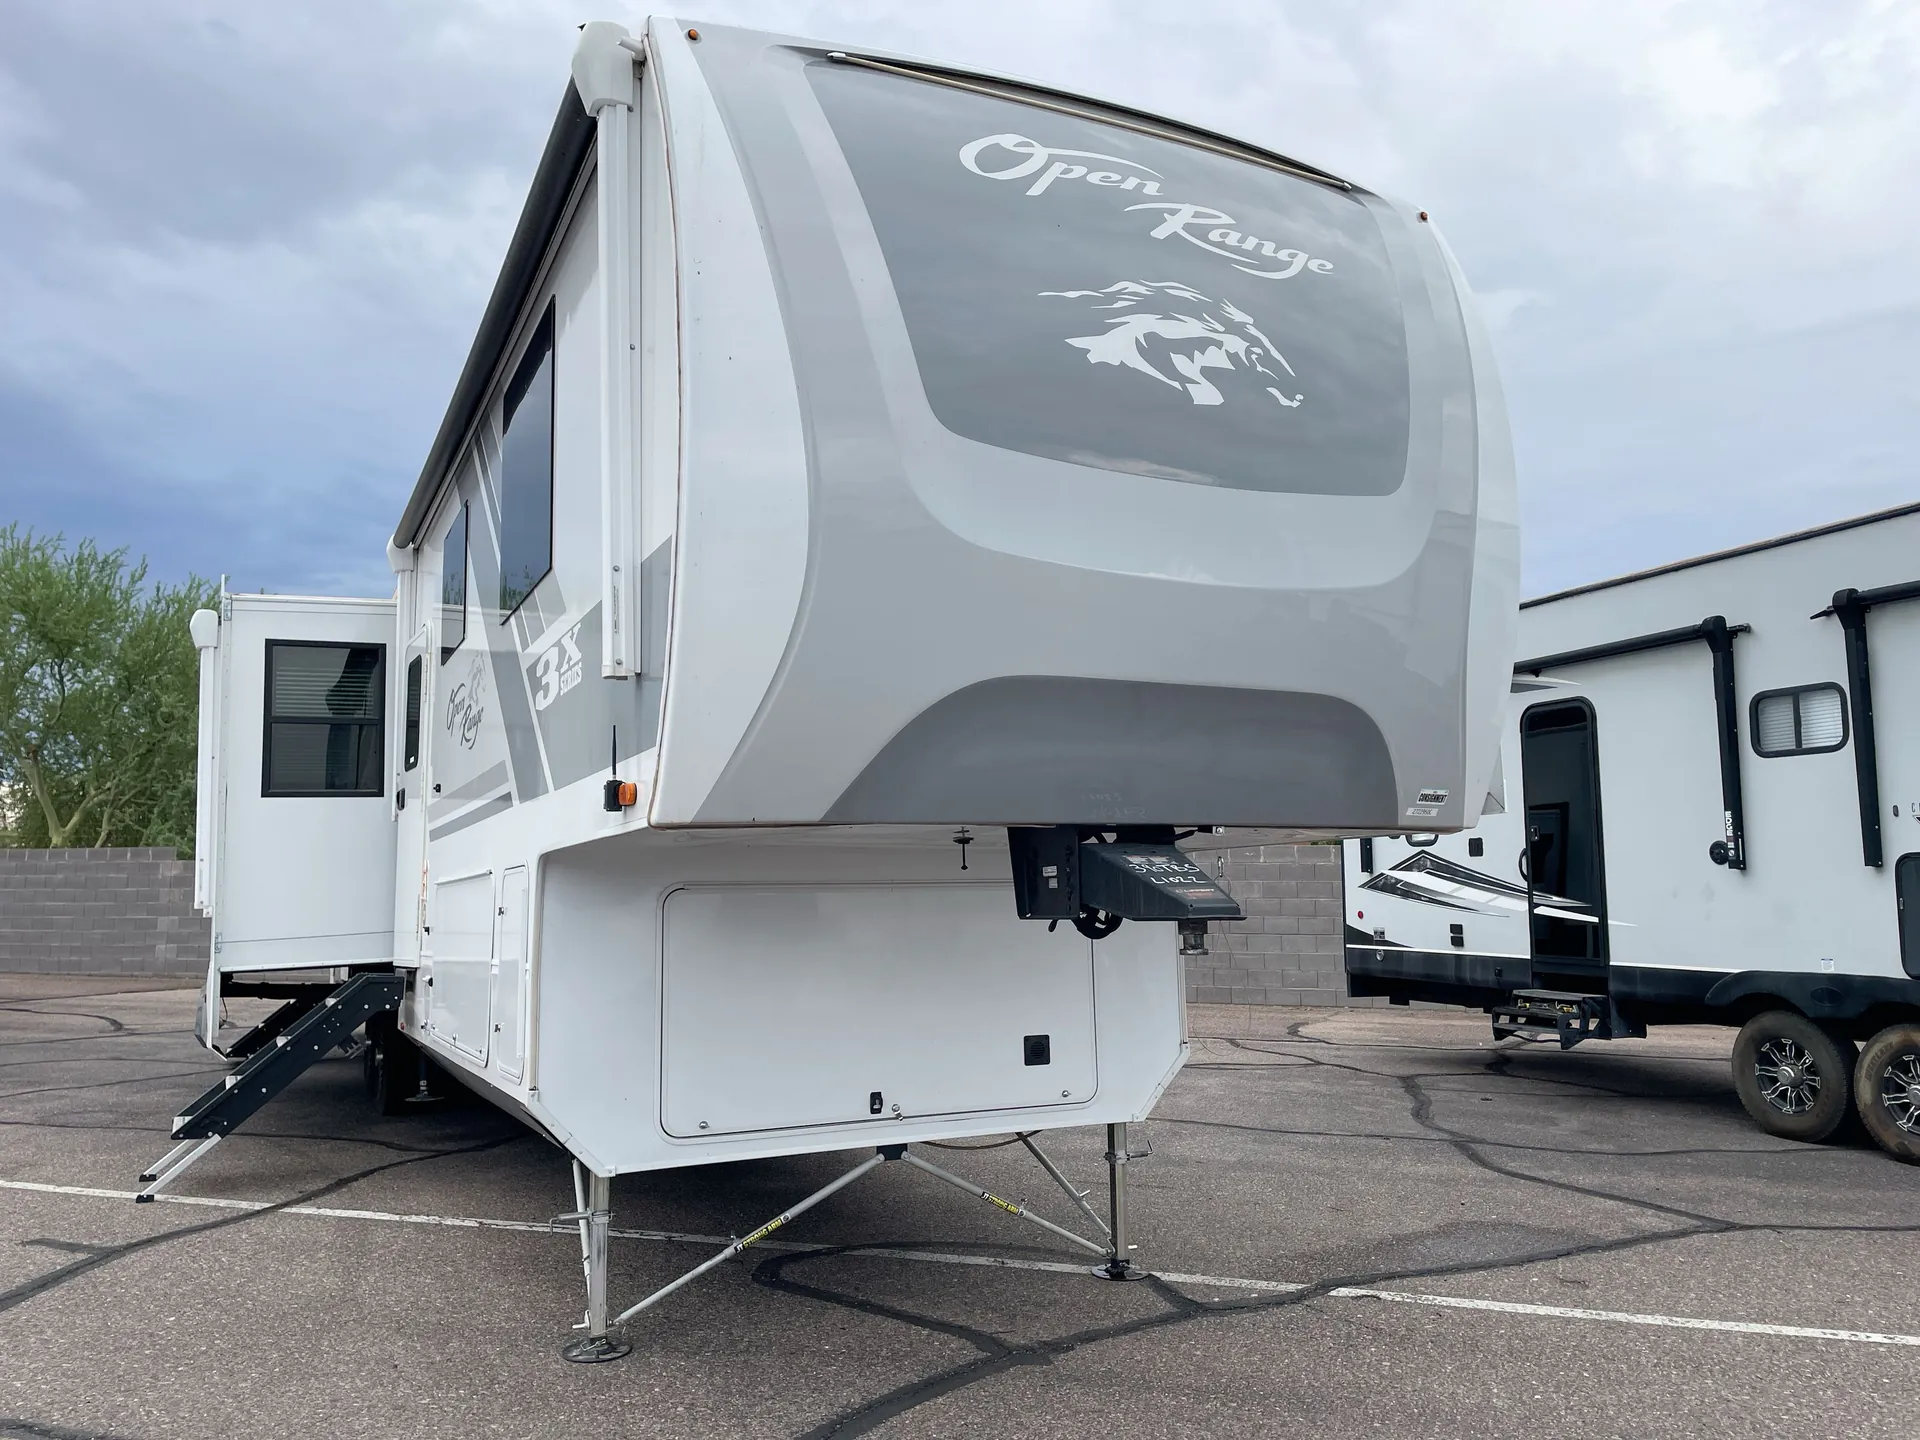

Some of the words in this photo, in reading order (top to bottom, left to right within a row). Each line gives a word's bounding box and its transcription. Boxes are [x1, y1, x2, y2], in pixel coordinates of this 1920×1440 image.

[959, 133, 1165, 196] Open
[1124, 202, 1334, 279] Range
[535, 621, 582, 711] 3X
[446, 682, 467, 738] Open
[459, 703, 484, 750] Range
[1911, 802, 1920, 813] C
[743, 1228, 769, 1248] STRONG
[767, 1219, 783, 1233] ARM
